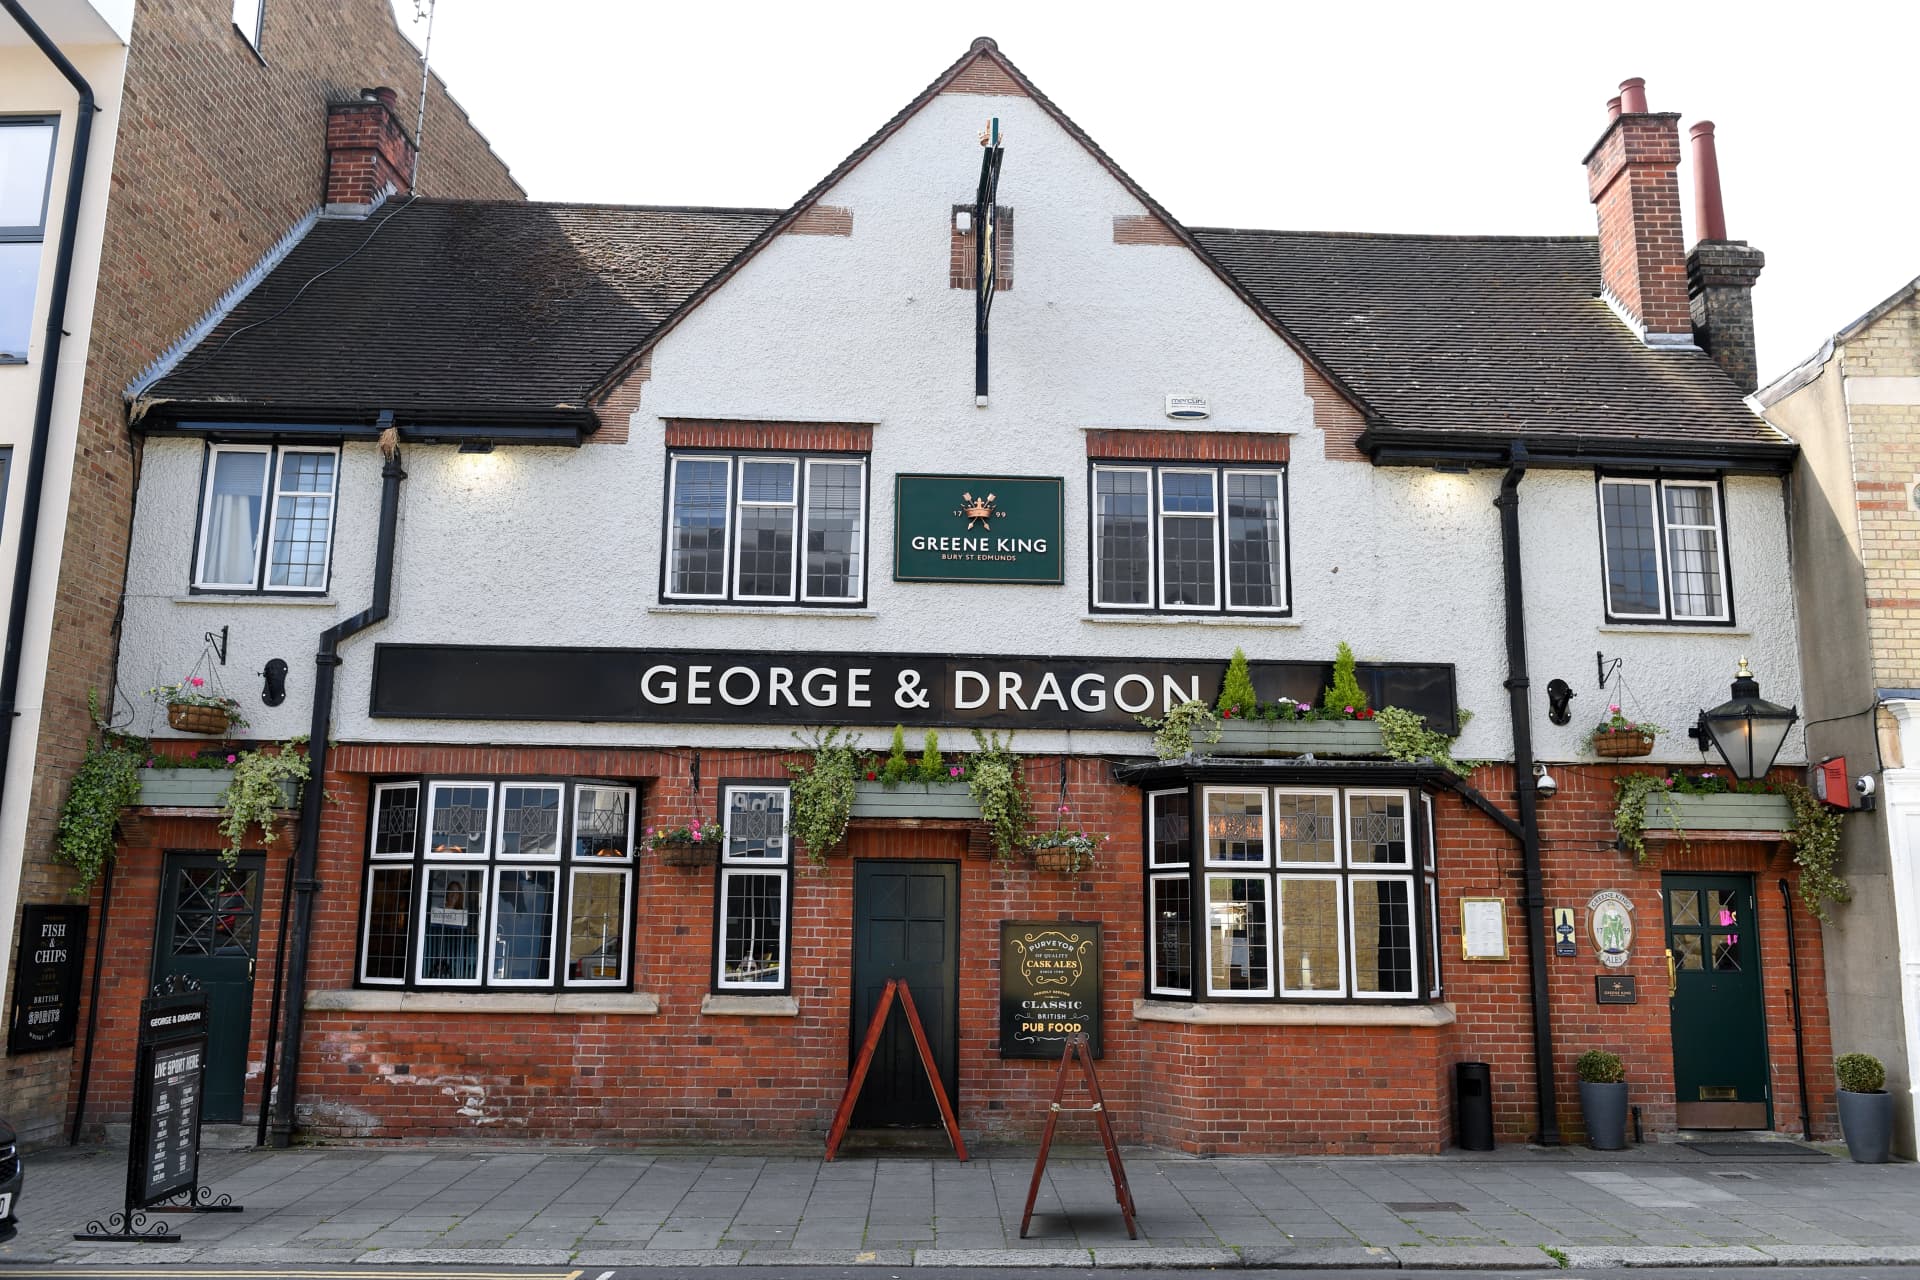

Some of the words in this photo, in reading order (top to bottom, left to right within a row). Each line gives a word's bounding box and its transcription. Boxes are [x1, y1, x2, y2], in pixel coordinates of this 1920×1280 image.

[911, 536, 989, 552] GREENE
[997, 538, 1047, 553] KING
[977, 554, 1017, 562] EDMUNDS
[640, 665, 872, 708] GEORGE
[894, 668, 930, 710] &
[954, 671, 1200, 714] DRAGON
[1591, 892, 1613, 907] GREENE
[1615, 893, 1633, 909] KING
[41, 924, 67, 937] FISH
[49, 938, 56, 948] &
[1028, 940, 1075, 952] PURVEYOR
[34, 949, 67, 964] CHIPS
[1605, 955, 1623, 964] ALES
[1026, 960, 1052, 968] CASK
[1053, 960, 1078, 969] ALES
[33, 994, 59, 1004] BRITISH
[1021, 1000, 1083, 1010] CLASSIC
[28, 1008, 61, 1025] SPIRITS
[150, 1015, 172, 1027] GEORGE
[177, 1011, 201, 1023] DRAGON
[1022, 1022, 1045, 1033] PUB
[1047, 1022, 1082, 1033] FOOD
[154, 1061, 167, 1079] LIVE
[167, 1057, 186, 1076] SPORT
[185, 1053, 200, 1072] HERE
